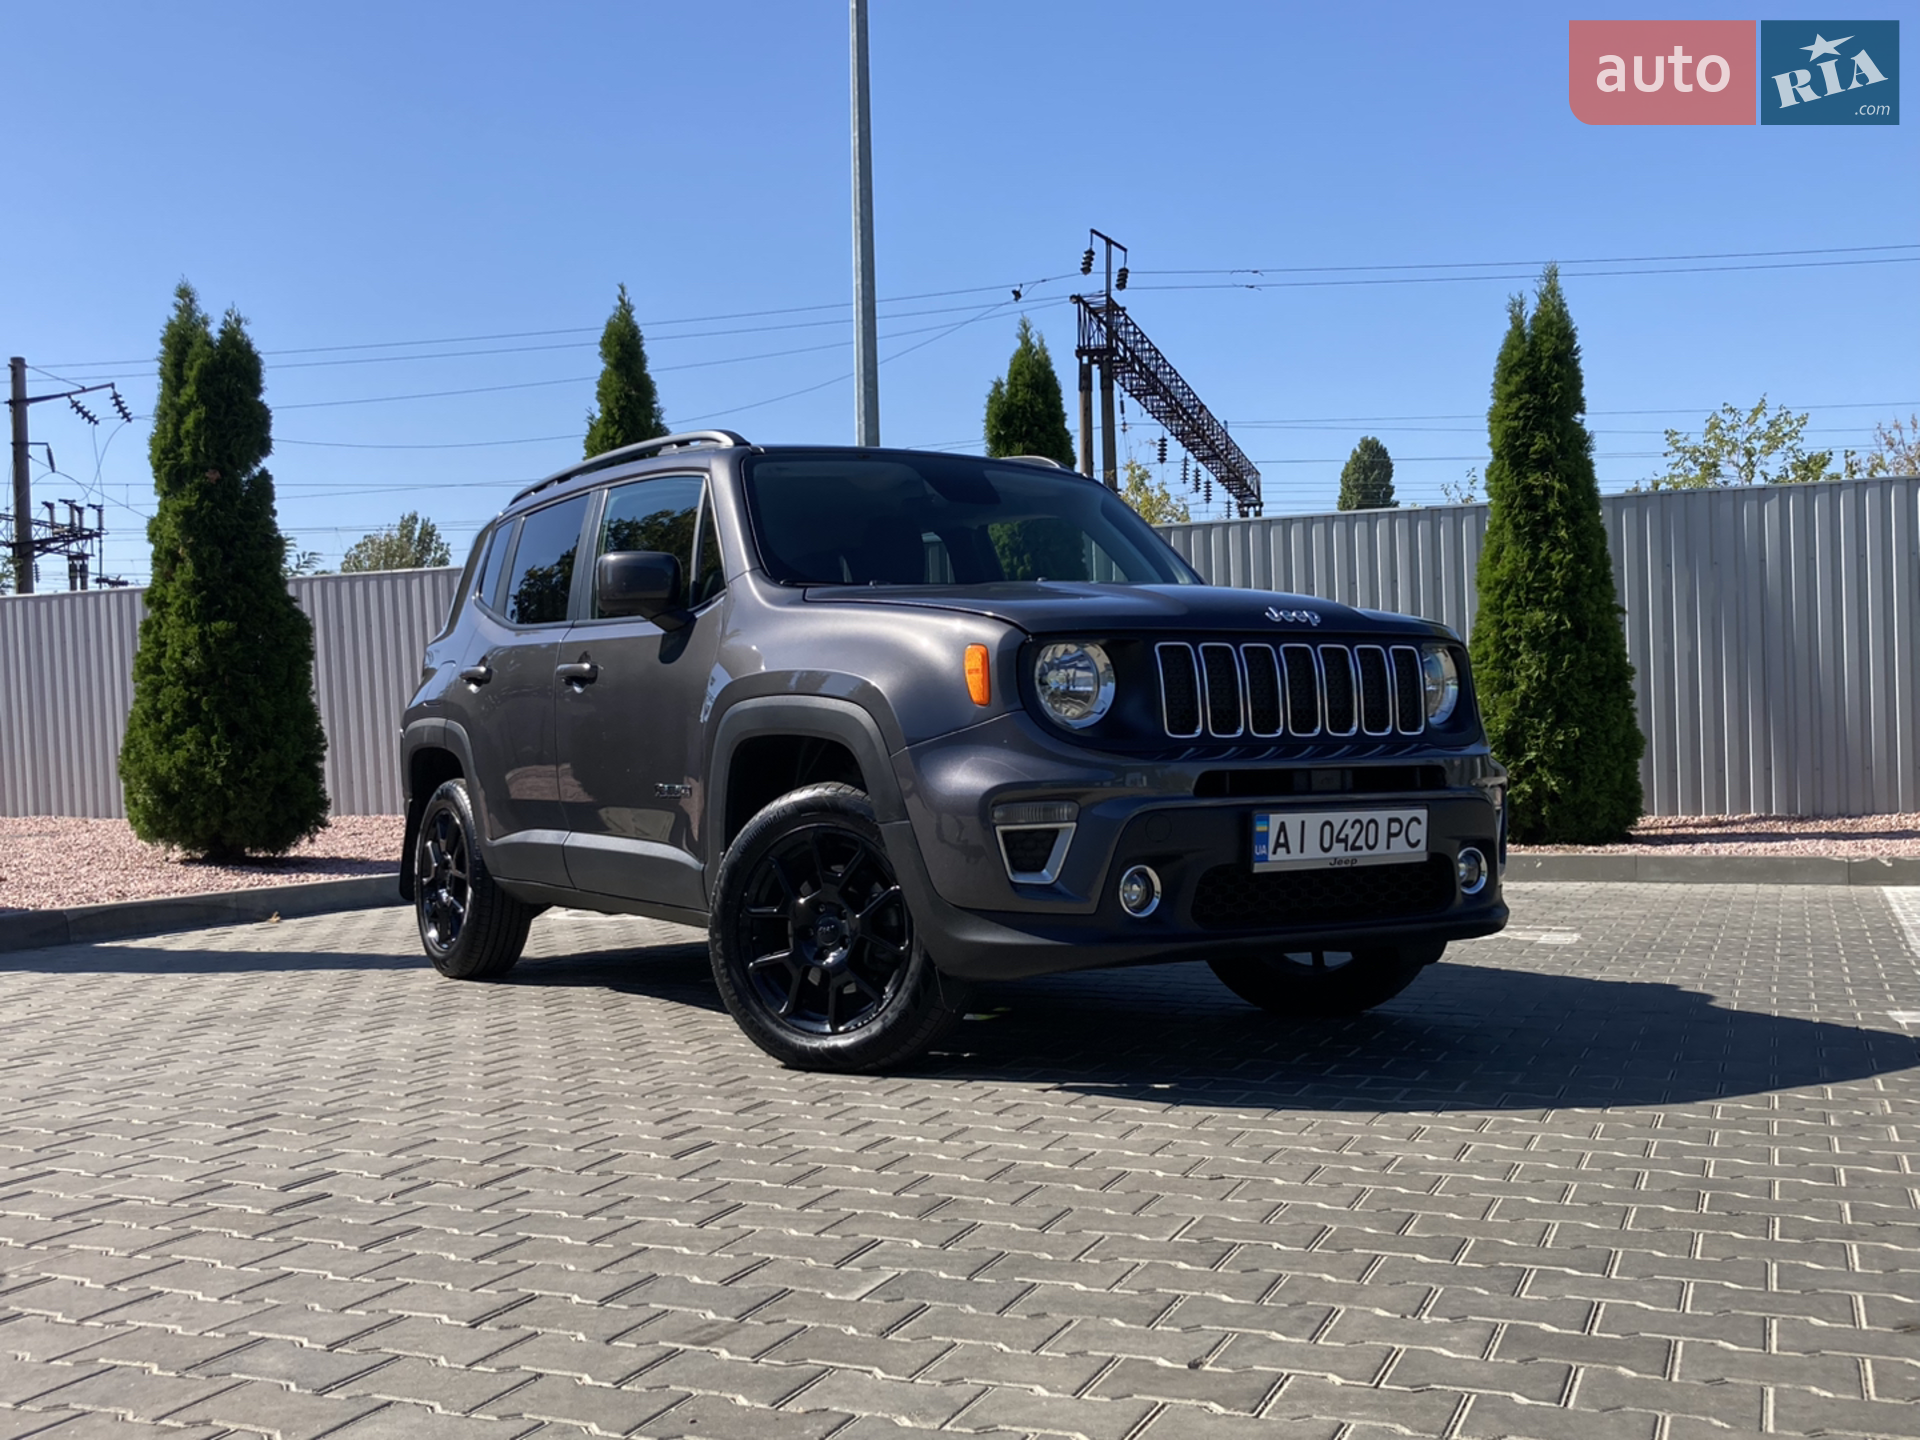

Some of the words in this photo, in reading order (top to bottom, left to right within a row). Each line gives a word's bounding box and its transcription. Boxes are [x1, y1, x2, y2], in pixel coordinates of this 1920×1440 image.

[1265, 606, 1321, 626] Jeep
[1271, 820, 1306, 855] AI
[1319, 818, 1379, 853] 0420
[1386, 815, 1422, 849] PC
[1254, 844, 1267, 856] UA
[1329, 857, 1358, 867] Jeep
